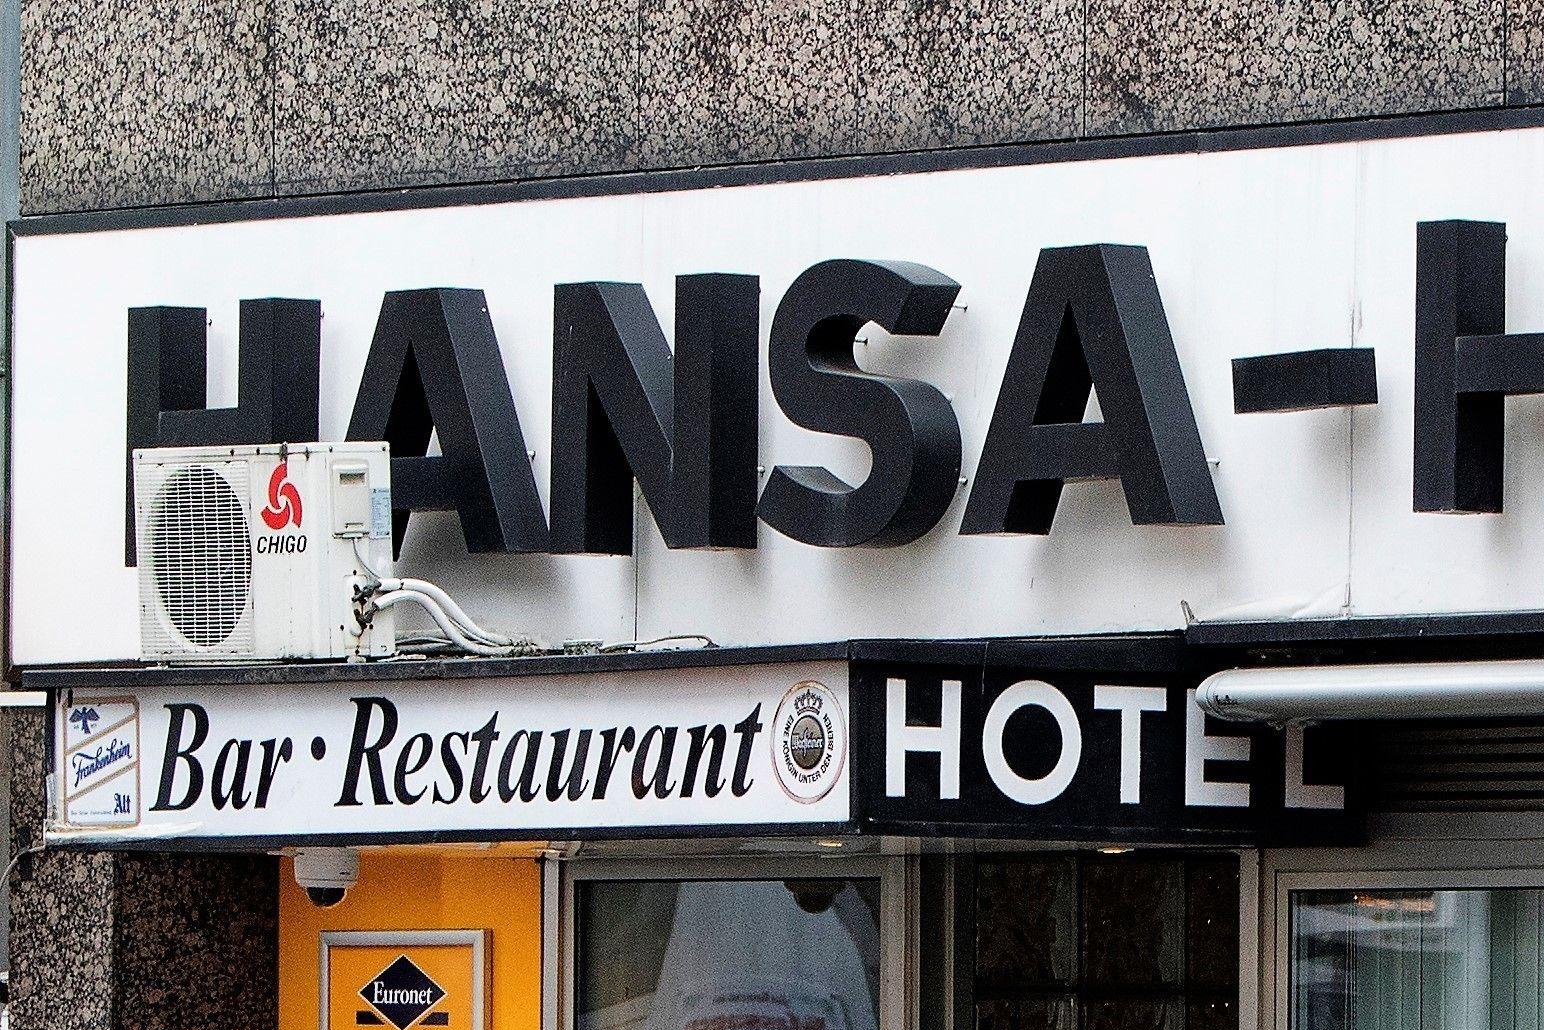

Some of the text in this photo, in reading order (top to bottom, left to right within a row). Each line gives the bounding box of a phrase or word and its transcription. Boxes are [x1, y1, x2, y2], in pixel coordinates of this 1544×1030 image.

[256, 535, 308, 554] CHIGO
[149, 696, 763, 812] Bar Restaurant
[885, 678, 1345, 810] HOTEL
[114, 793, 131, 815] Alt
[372, 980, 433, 1005] Euronet
